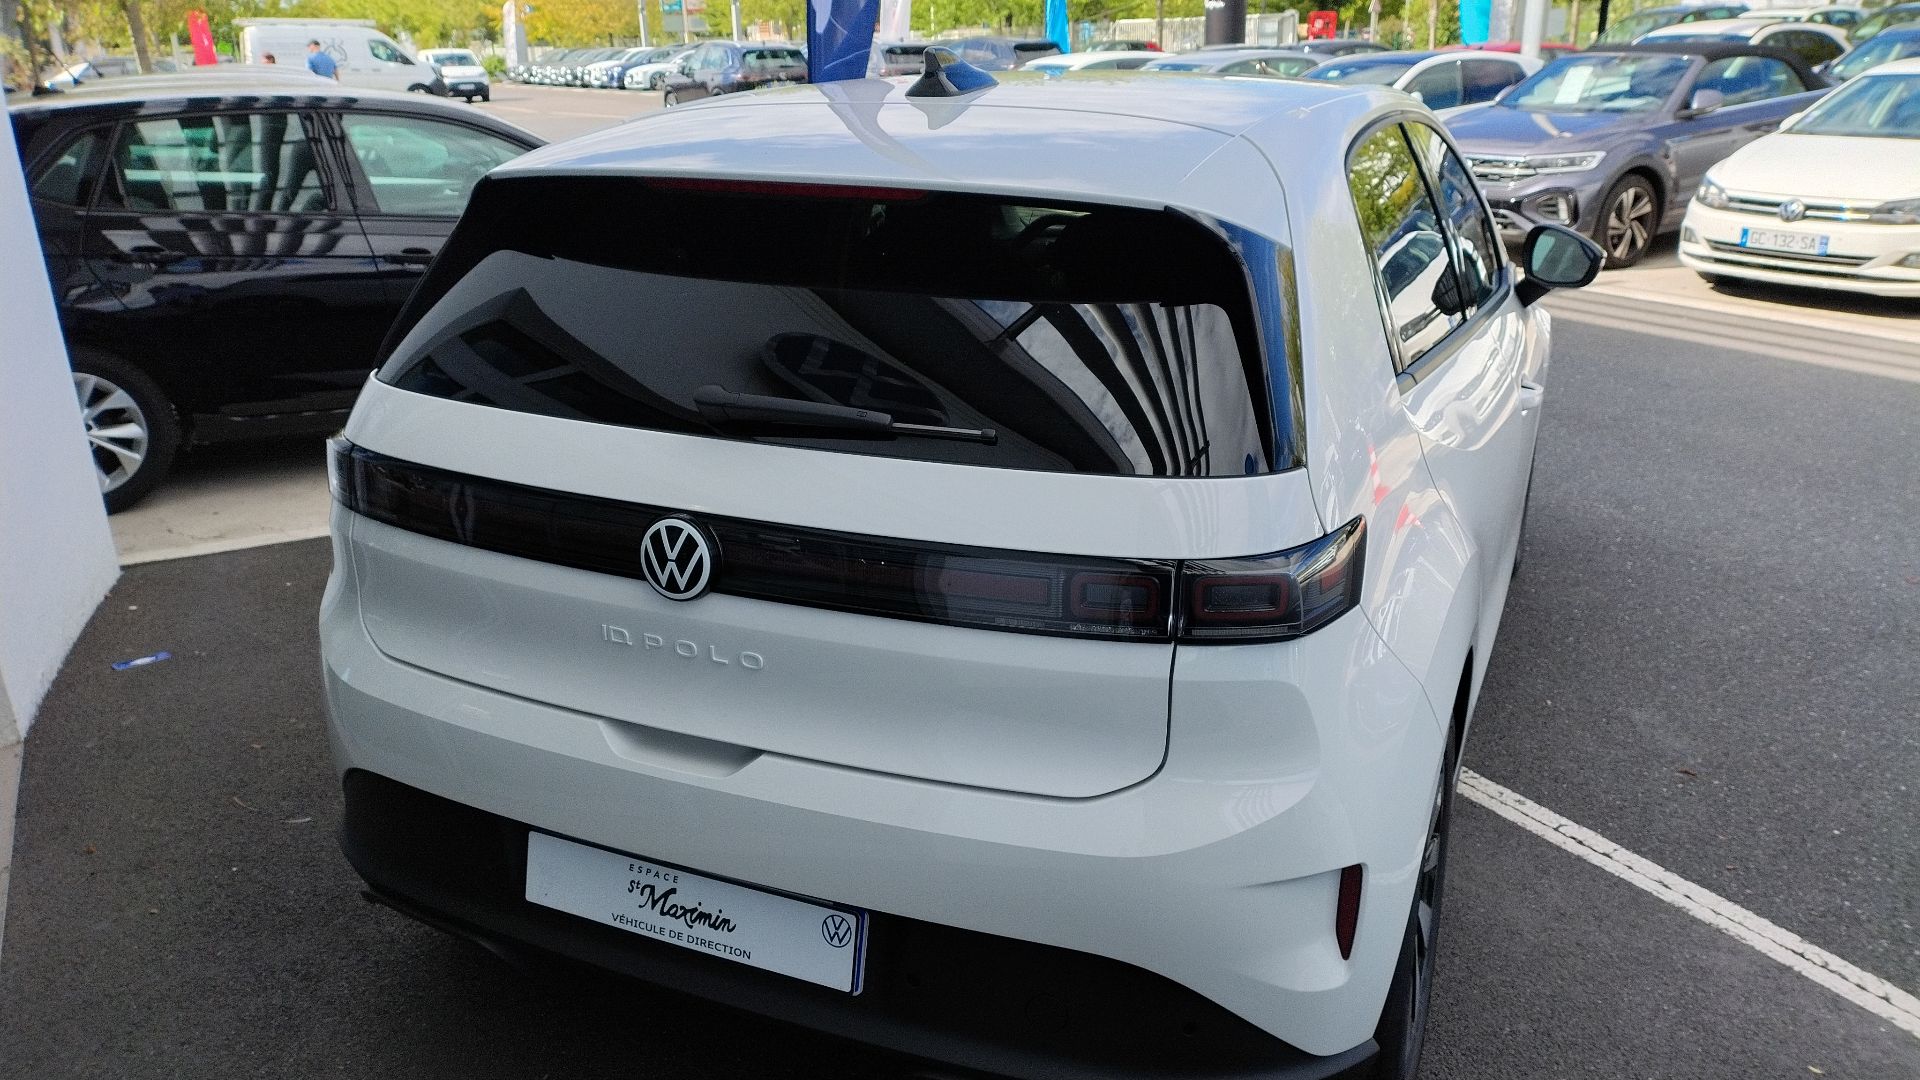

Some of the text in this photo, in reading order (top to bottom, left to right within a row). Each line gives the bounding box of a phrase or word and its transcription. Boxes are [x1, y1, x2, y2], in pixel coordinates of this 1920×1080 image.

[643, 632, 764, 670] POLO
[628, 863, 679, 884] ESPACE
[627, 879, 737, 933] St Maximin
[611, 912, 752, 960] VÉHICULE DE DIRECTION
